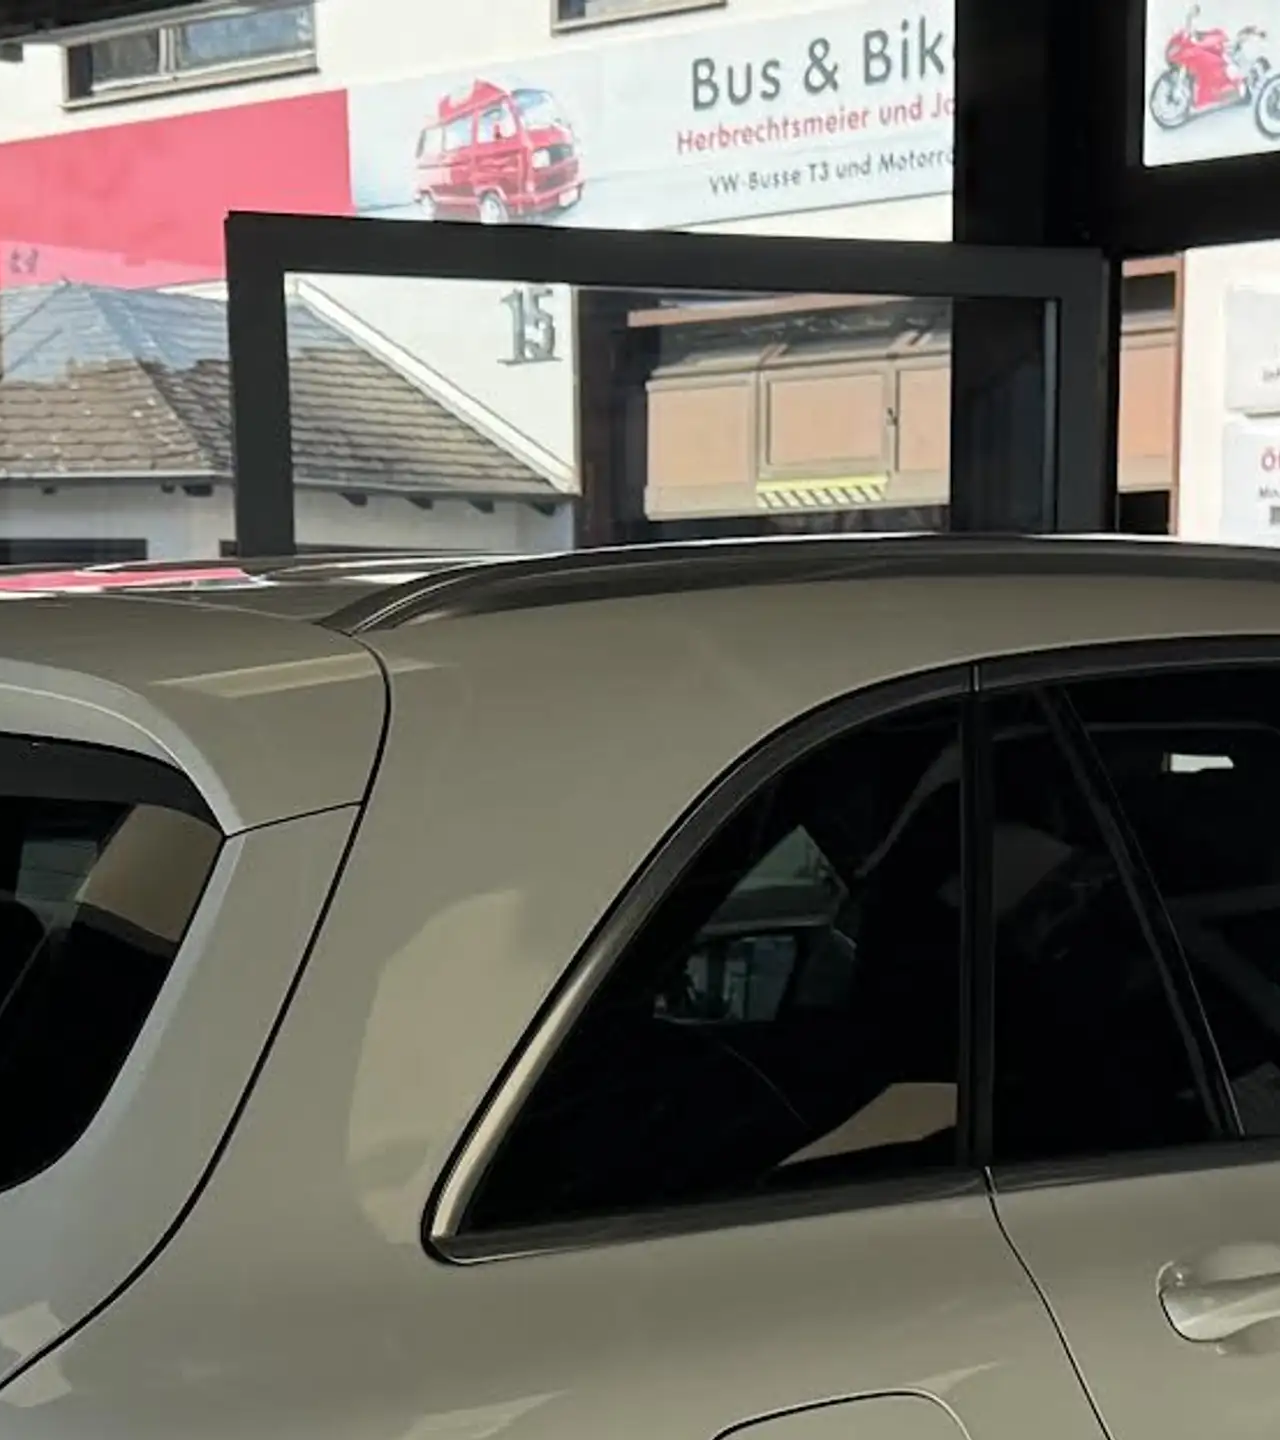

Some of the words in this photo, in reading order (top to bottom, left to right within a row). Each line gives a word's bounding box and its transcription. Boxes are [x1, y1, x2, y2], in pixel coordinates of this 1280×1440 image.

[692, 57, 781, 112] Bus
[804, 37, 840, 94] &
[676, 105, 870, 154] Herbrechtsmeier
[879, 93, 923, 126] und
[836, 153, 871, 180] und
[497, 285, 563, 366] 15
